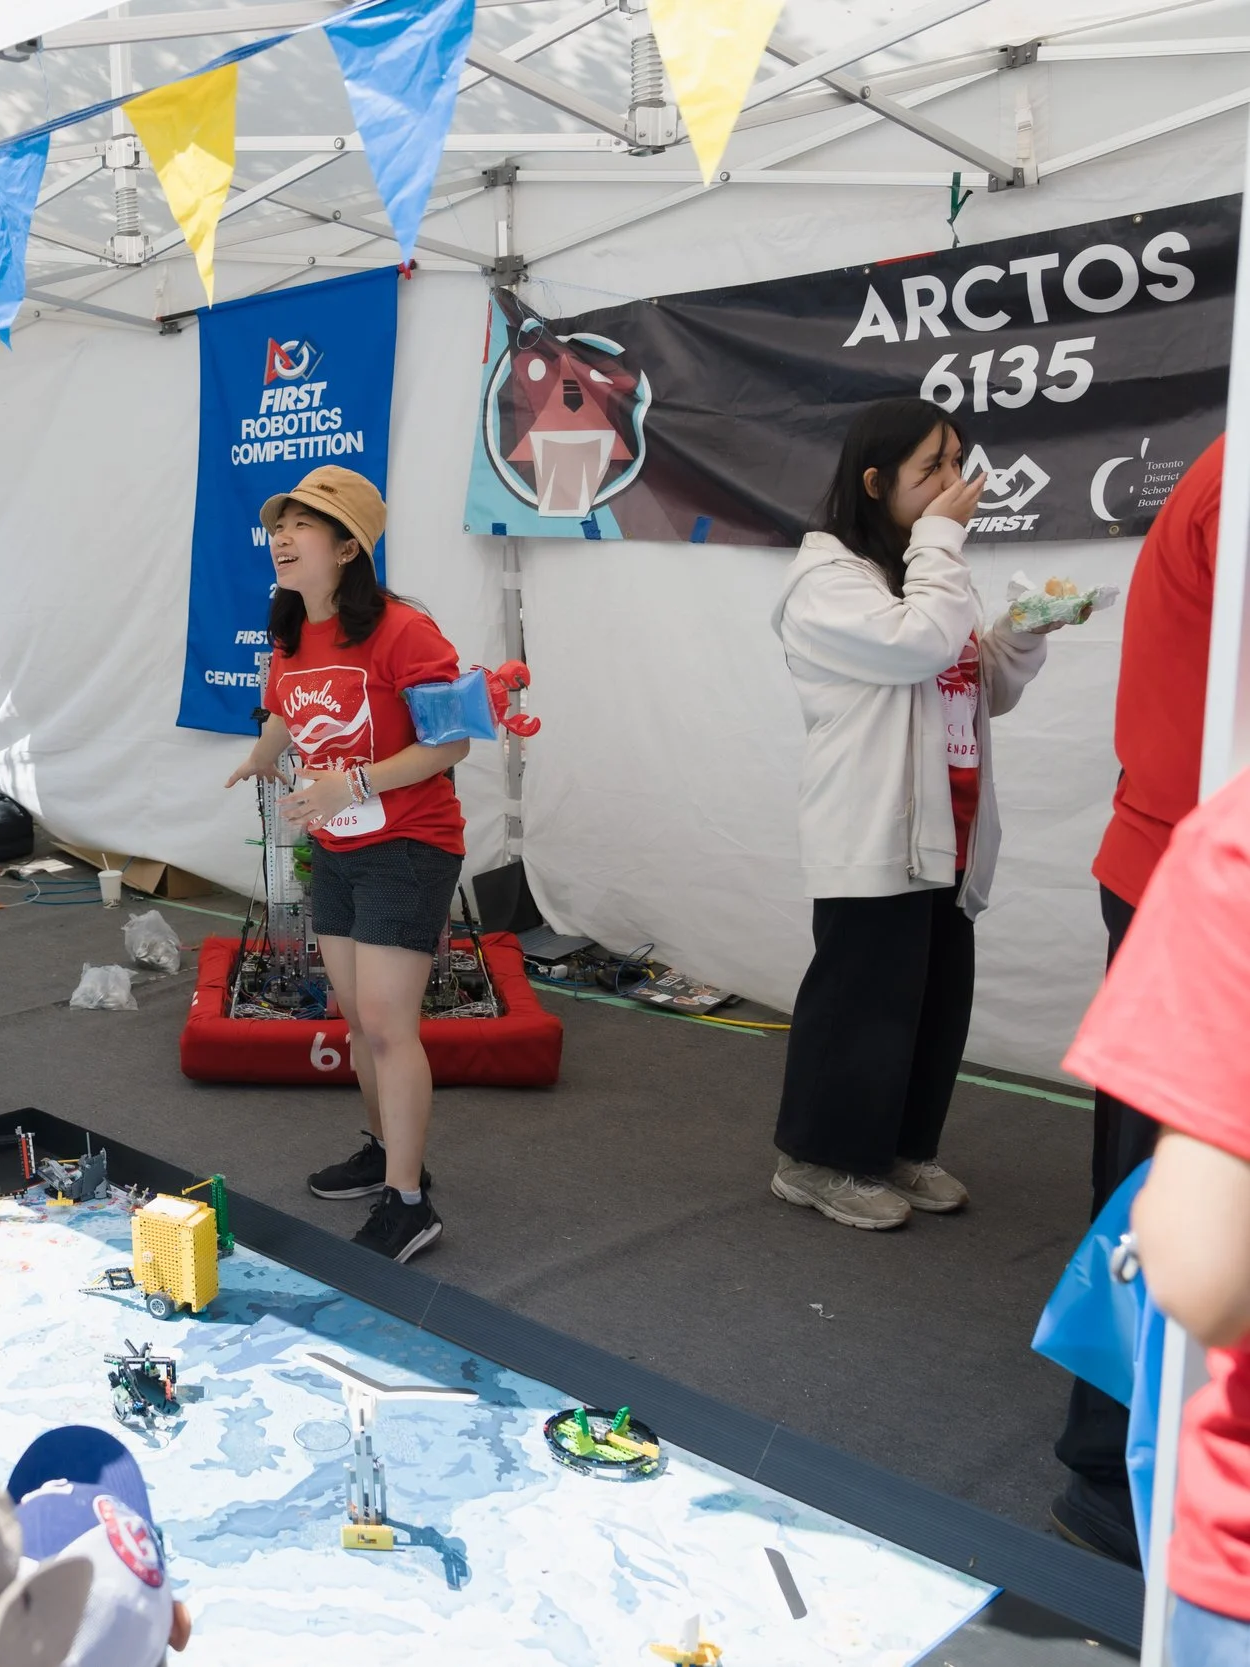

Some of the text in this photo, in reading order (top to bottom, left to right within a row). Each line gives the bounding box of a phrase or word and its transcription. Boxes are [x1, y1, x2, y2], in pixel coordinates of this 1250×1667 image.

[841, 231, 1196, 347] ARCTOS
[920, 336, 1096, 414] 6135
[259, 381, 328, 414] FIRST
[241, 407, 342, 440] ROBOTICS
[231, 430, 364, 466] COMPETITION
[1144, 472, 1179, 483] District
[1146, 460, 1184, 470] Toronto
[1137, 497, 1167, 507] Board
[1141, 484, 1174, 495] School
[283, 679, 342, 719] Wonder
